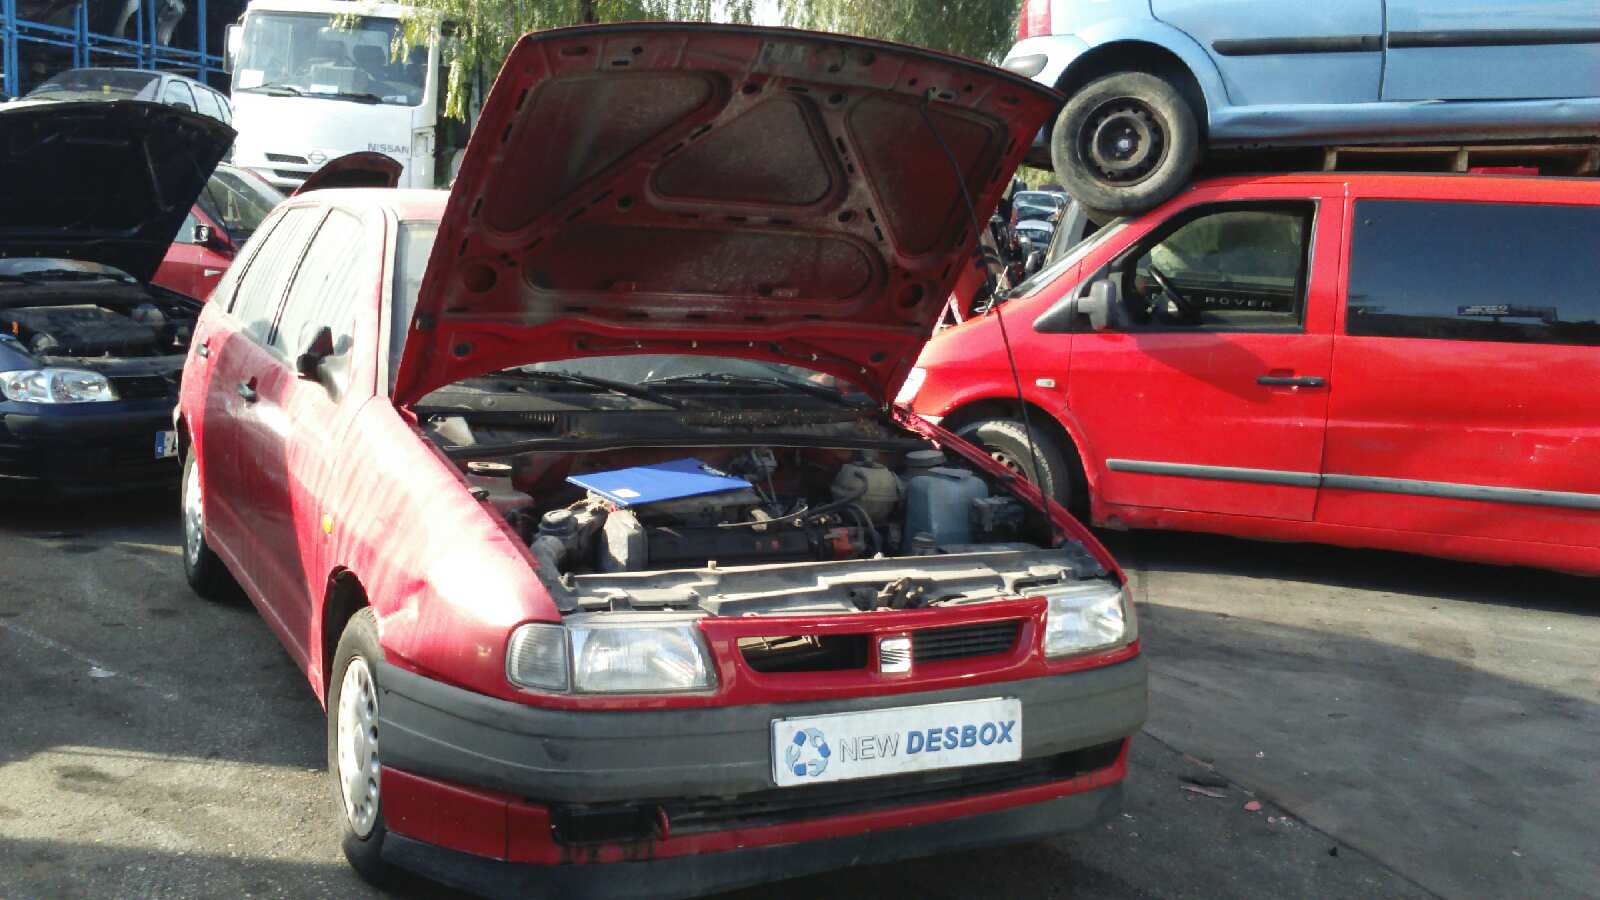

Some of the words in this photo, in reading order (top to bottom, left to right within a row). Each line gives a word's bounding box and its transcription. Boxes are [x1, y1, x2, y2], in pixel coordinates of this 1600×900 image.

[367, 143, 409, 153] NISSAN
[1205, 296, 1272, 307] ROVER
[839, 733, 900, 762] NEW
[906, 720, 1015, 754] DESBOX
